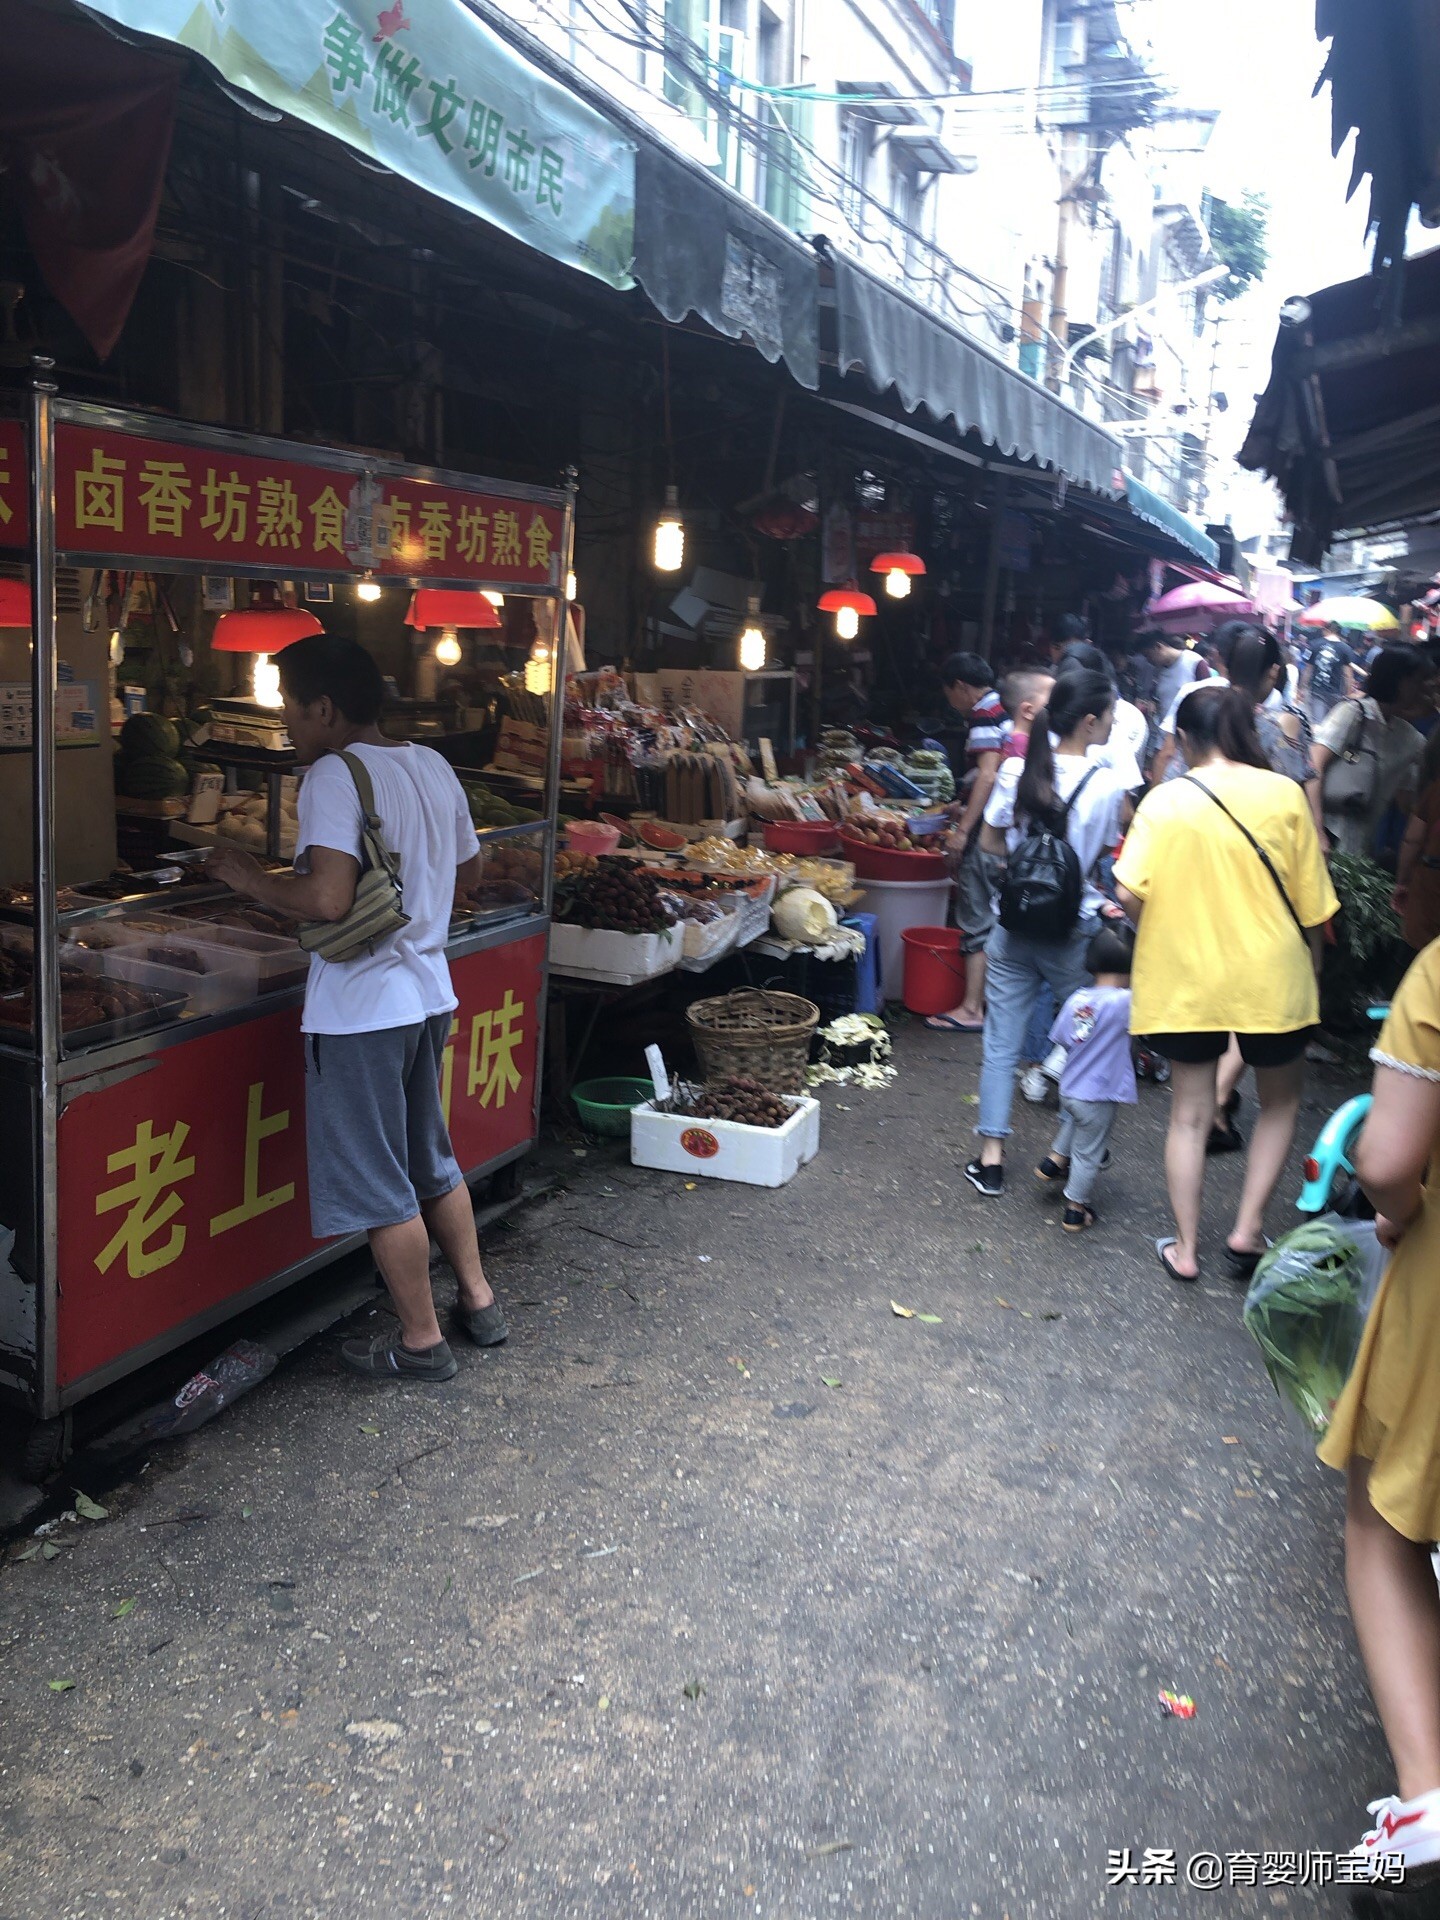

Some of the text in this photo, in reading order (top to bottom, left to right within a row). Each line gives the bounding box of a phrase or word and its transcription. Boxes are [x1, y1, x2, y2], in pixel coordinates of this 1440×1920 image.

[323, 15, 564, 216] 争做文明市民
[75, 449, 346, 554] 卤香坊熟食
